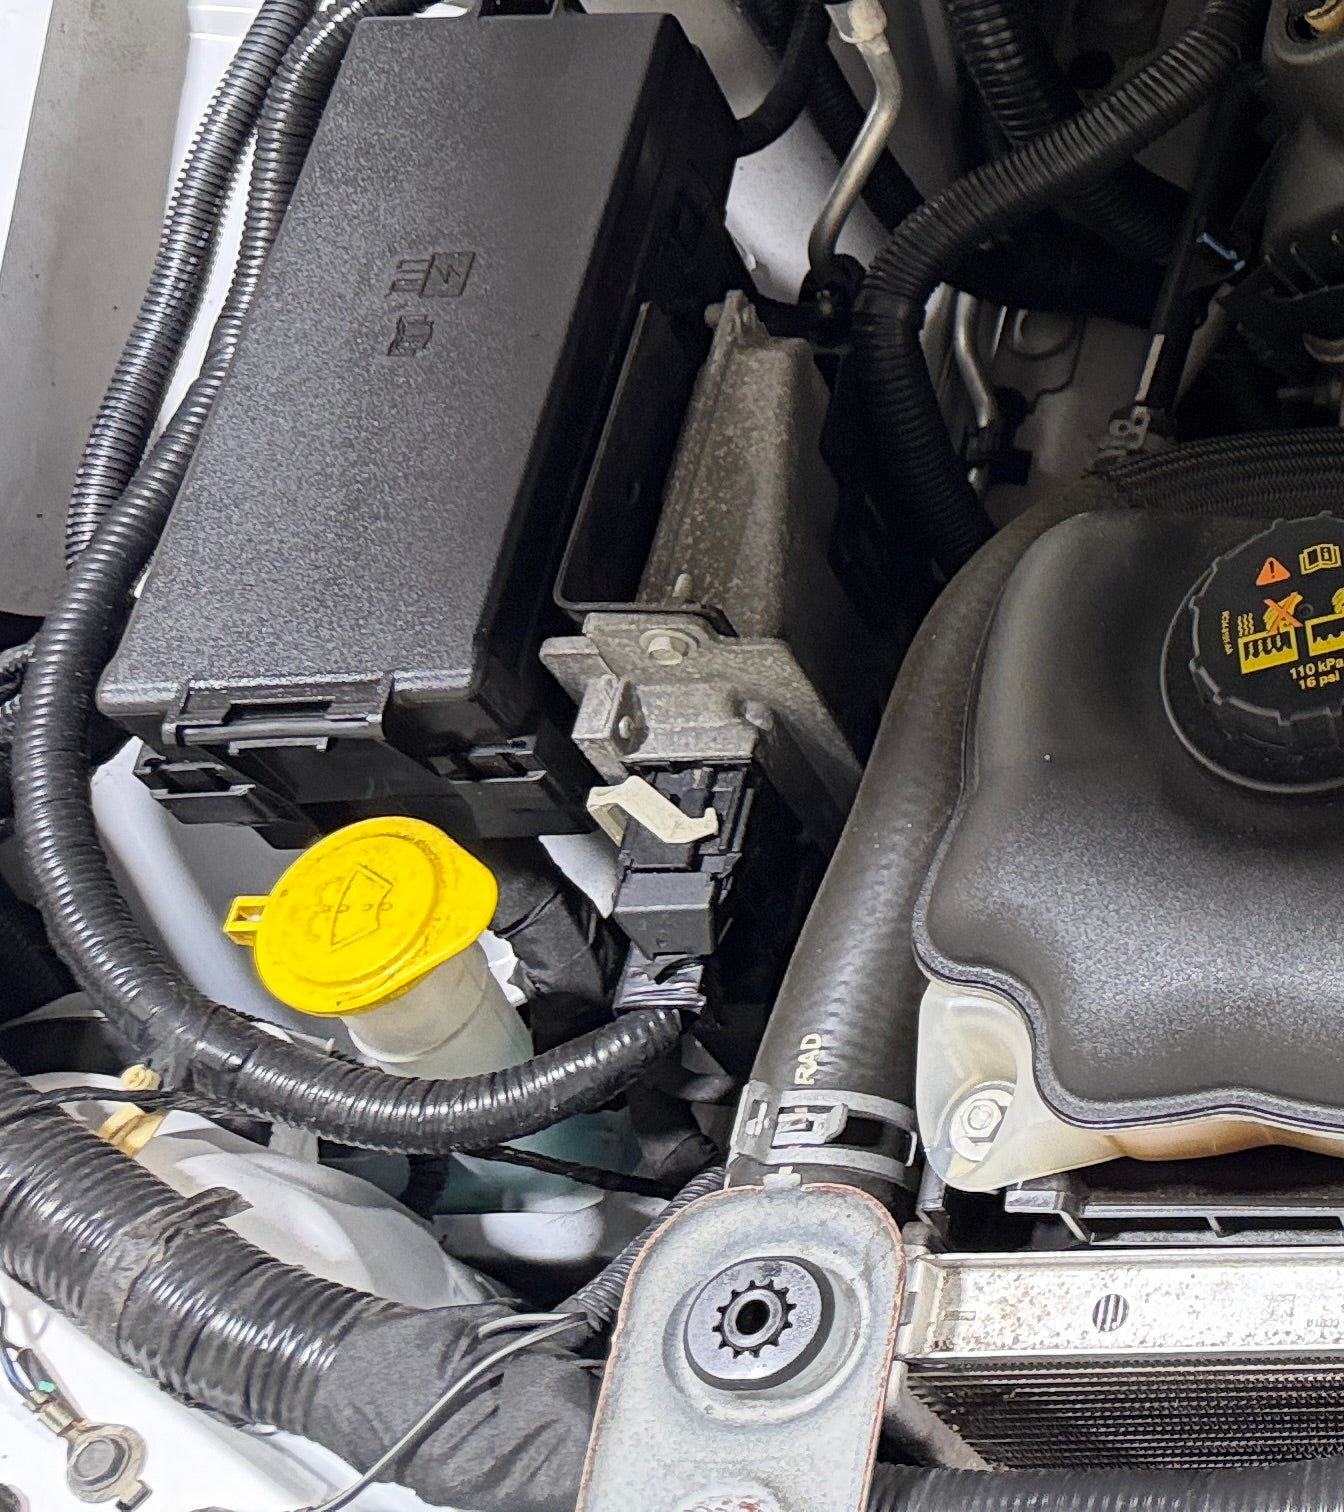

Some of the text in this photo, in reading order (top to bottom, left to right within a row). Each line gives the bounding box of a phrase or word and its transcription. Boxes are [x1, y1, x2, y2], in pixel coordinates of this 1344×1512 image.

[1289, 657, 1344, 681] 110 kPa
[1299, 671, 1340, 690] 16 psi
[793, 1032, 822, 1085] RAD
